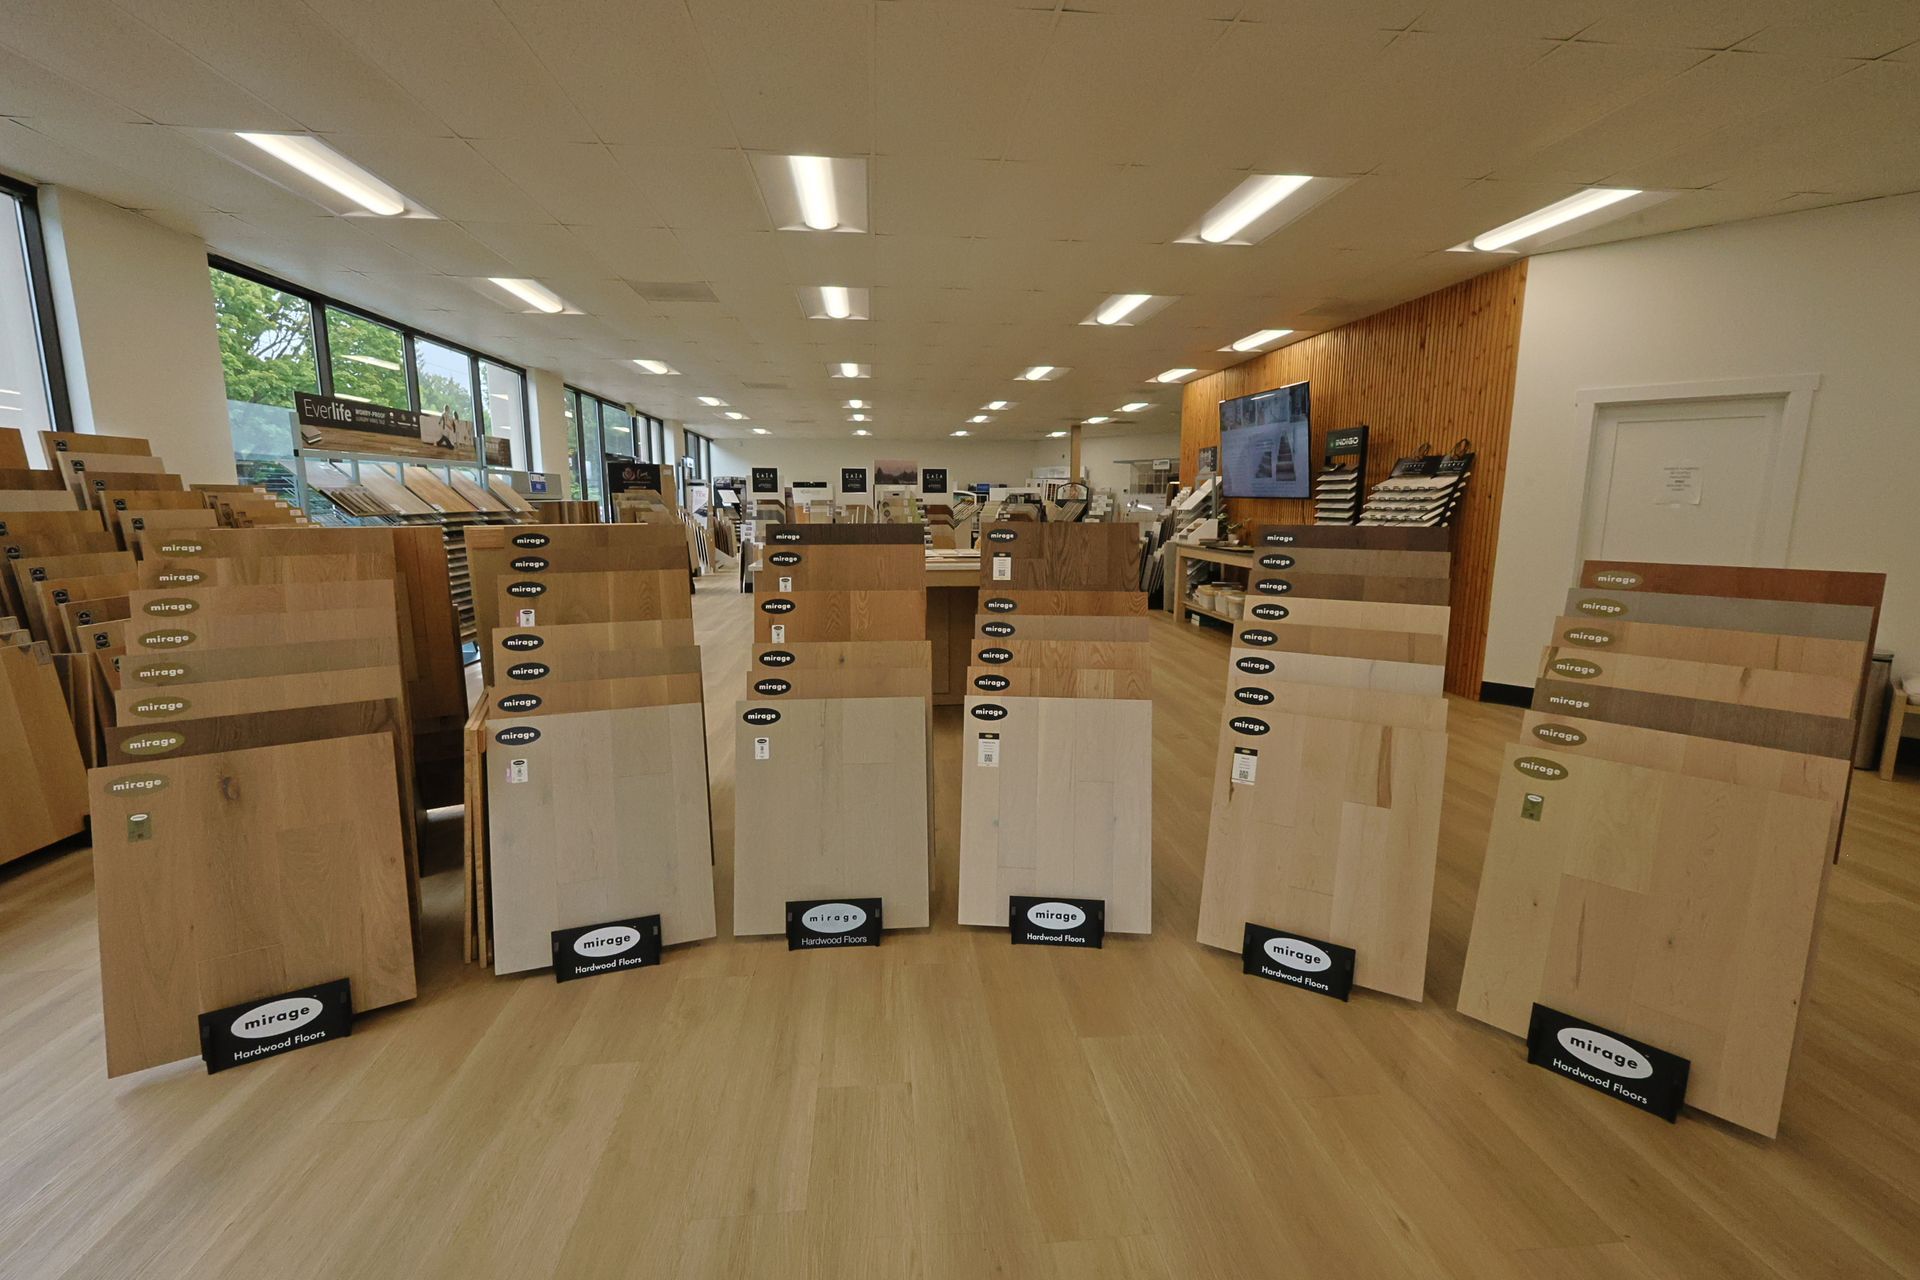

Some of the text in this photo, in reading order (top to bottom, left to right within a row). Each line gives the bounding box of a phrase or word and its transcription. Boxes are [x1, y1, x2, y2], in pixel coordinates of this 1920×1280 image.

[303, 398, 352, 422] Everlife
[1335, 436, 1359, 446] INDIGO
[516, 537, 545, 545] mirage
[1267, 535, 1293, 543] mirage
[162, 544, 202, 552] mirage
[515, 560, 544, 568] mirage
[1263, 558, 1290, 566] mirage
[1598, 575, 1636, 584] mirage
[1259, 583, 1287, 591] mirage
[150, 603, 192, 611] mirage
[1256, 608, 1285, 616] mirage
[1582, 602, 1621, 613] mirage
[985, 626, 1011, 634] mirage
[146, 635, 189, 643] mirage
[1244, 633, 1273, 642] mirage
[1570, 632, 1609, 642] mirage
[507, 639, 539, 647] mirage
[982, 652, 1009, 660] mirage
[1240, 661, 1270, 670] mirage
[1556, 663, 1595, 675] mirage
[139, 668, 184, 678] mirage
[759, 683, 787, 691] mirage
[978, 679, 1006, 687] mirage
[1239, 691, 1269, 701] mirage
[137, 702, 183, 712] mirage
[504, 699, 537, 707] mirage
[1550, 696, 1590, 708] mirage
[747, 713, 776, 721] mirage
[975, 708, 1003, 717] mirage
[1234, 721, 1265, 731] mirage
[501, 731, 535, 740] mirage
[1539, 729, 1580, 741] mirage
[129, 737, 176, 749] mirage
[1520, 761, 1561, 776] mirage
[113, 779, 162, 791] mirage
[809, 914, 858, 923] mirage
[1035, 909, 1077, 922] mirage
[583, 935, 631, 949] mirage
[801, 935, 868, 946] Hardwood Floors
[1026, 932, 1086, 943] Hardwood Floors
[1273, 945, 1321, 964] mirage
[575, 957, 642, 974] Hardwood Floors
[1261, 965, 1329, 991] Hardwood Floors
[244, 1006, 310, 1031] mirage
[233, 1030, 326, 1061] Hardwood Floors
[1570, 1036, 1639, 1070] mirage
[1552, 1058, 1648, 1105] Hardwood Floors
